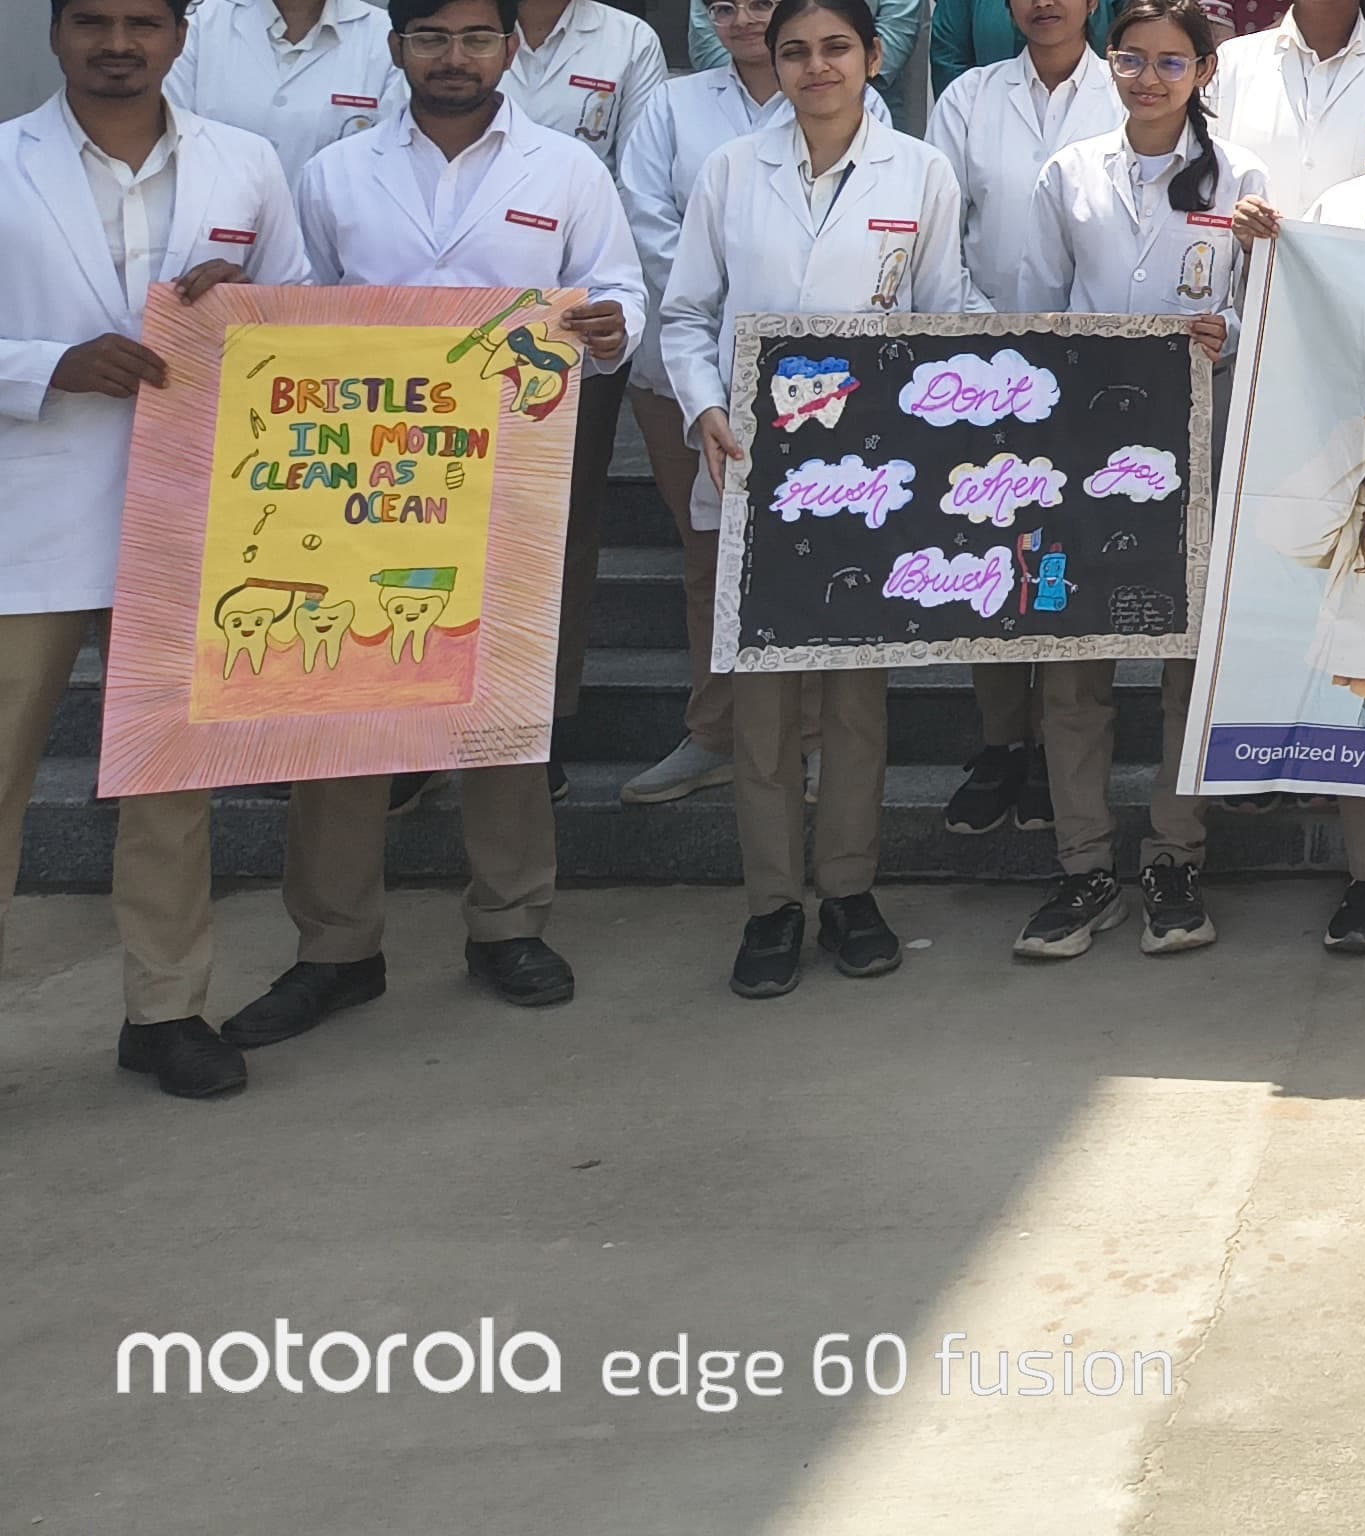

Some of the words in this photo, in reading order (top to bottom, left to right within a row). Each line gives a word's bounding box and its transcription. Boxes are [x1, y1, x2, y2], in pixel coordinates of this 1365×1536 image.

[270, 376, 457, 415] BRISTLES
[911, 370, 1034, 415] Don't
[288, 421, 350, 457] IN
[370, 421, 490, 459] MOTION
[250, 460, 358, 490] CLEAN
[368, 460, 418, 487] AS
[776, 468, 891, 528] rush
[951, 458, 1055, 524] when
[1090, 454, 1167, 494] you
[344, 491, 448, 524] OCEAN
[888, 553, 1006, 606] Brush
[1235, 742, 1336, 766] Organized
